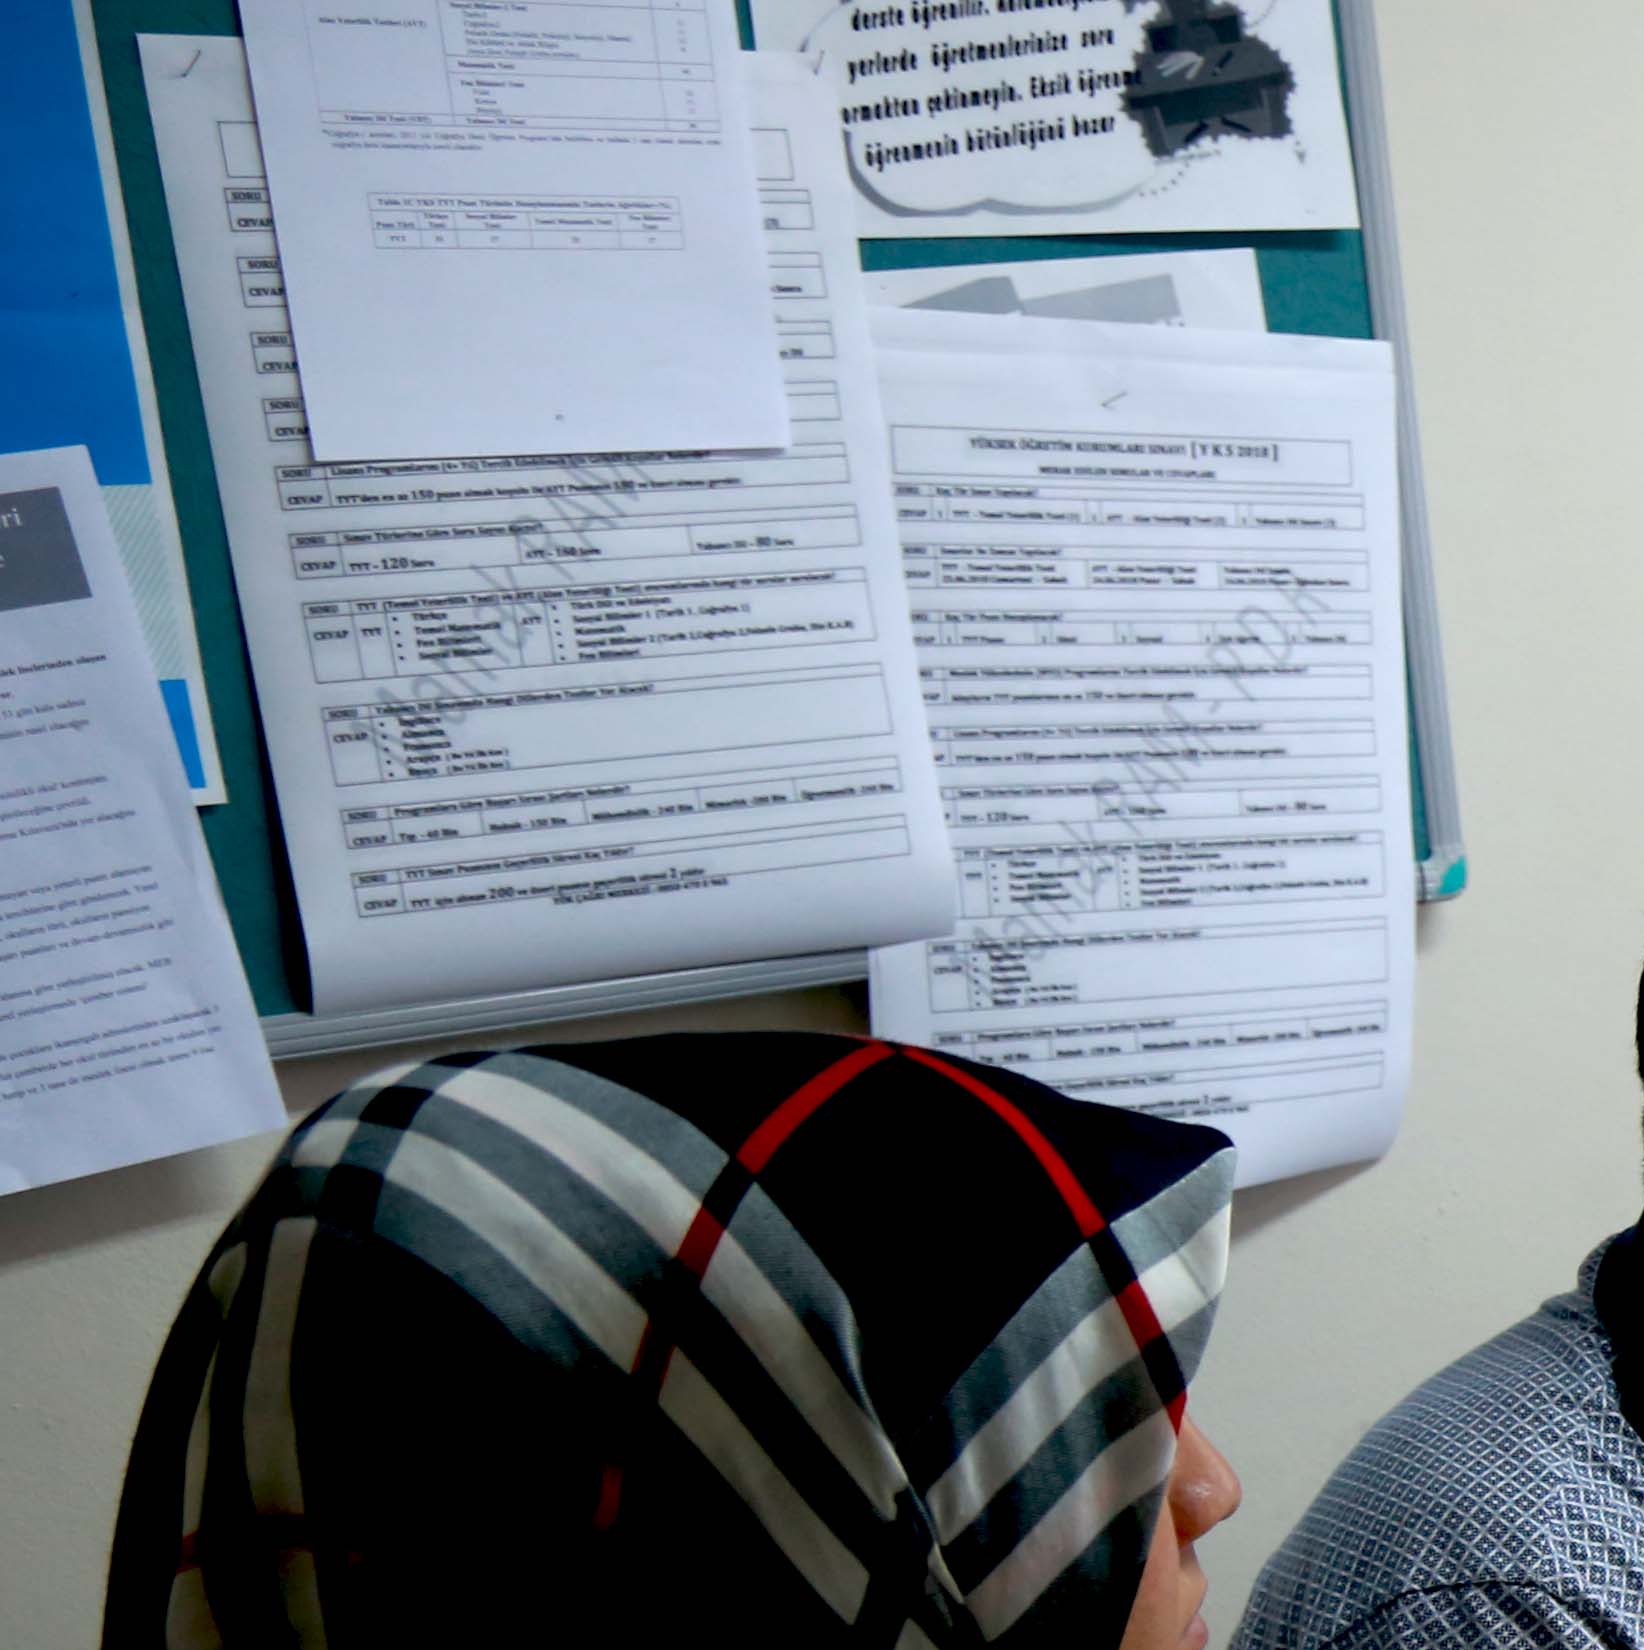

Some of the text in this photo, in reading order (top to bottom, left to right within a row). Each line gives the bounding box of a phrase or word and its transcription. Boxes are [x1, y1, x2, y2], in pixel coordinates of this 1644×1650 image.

[852, 7, 904, 31] derste
[848, 28, 1114, 84] yerlerde öğretmenlerinize soru
[841, 96, 920, 125] ormaktan
[927, 81, 1022, 117] çekinmeyin.
[1030, 75, 1072, 99] Eksik
[865, 114, 1115, 172] öğrenmenin bütünlüğünü bozar
[1213, 446, 1223, 456] K
[411, 488, 434, 501] 150
[382, 556, 408, 571] 120
[488, 886, 516, 899] 200
